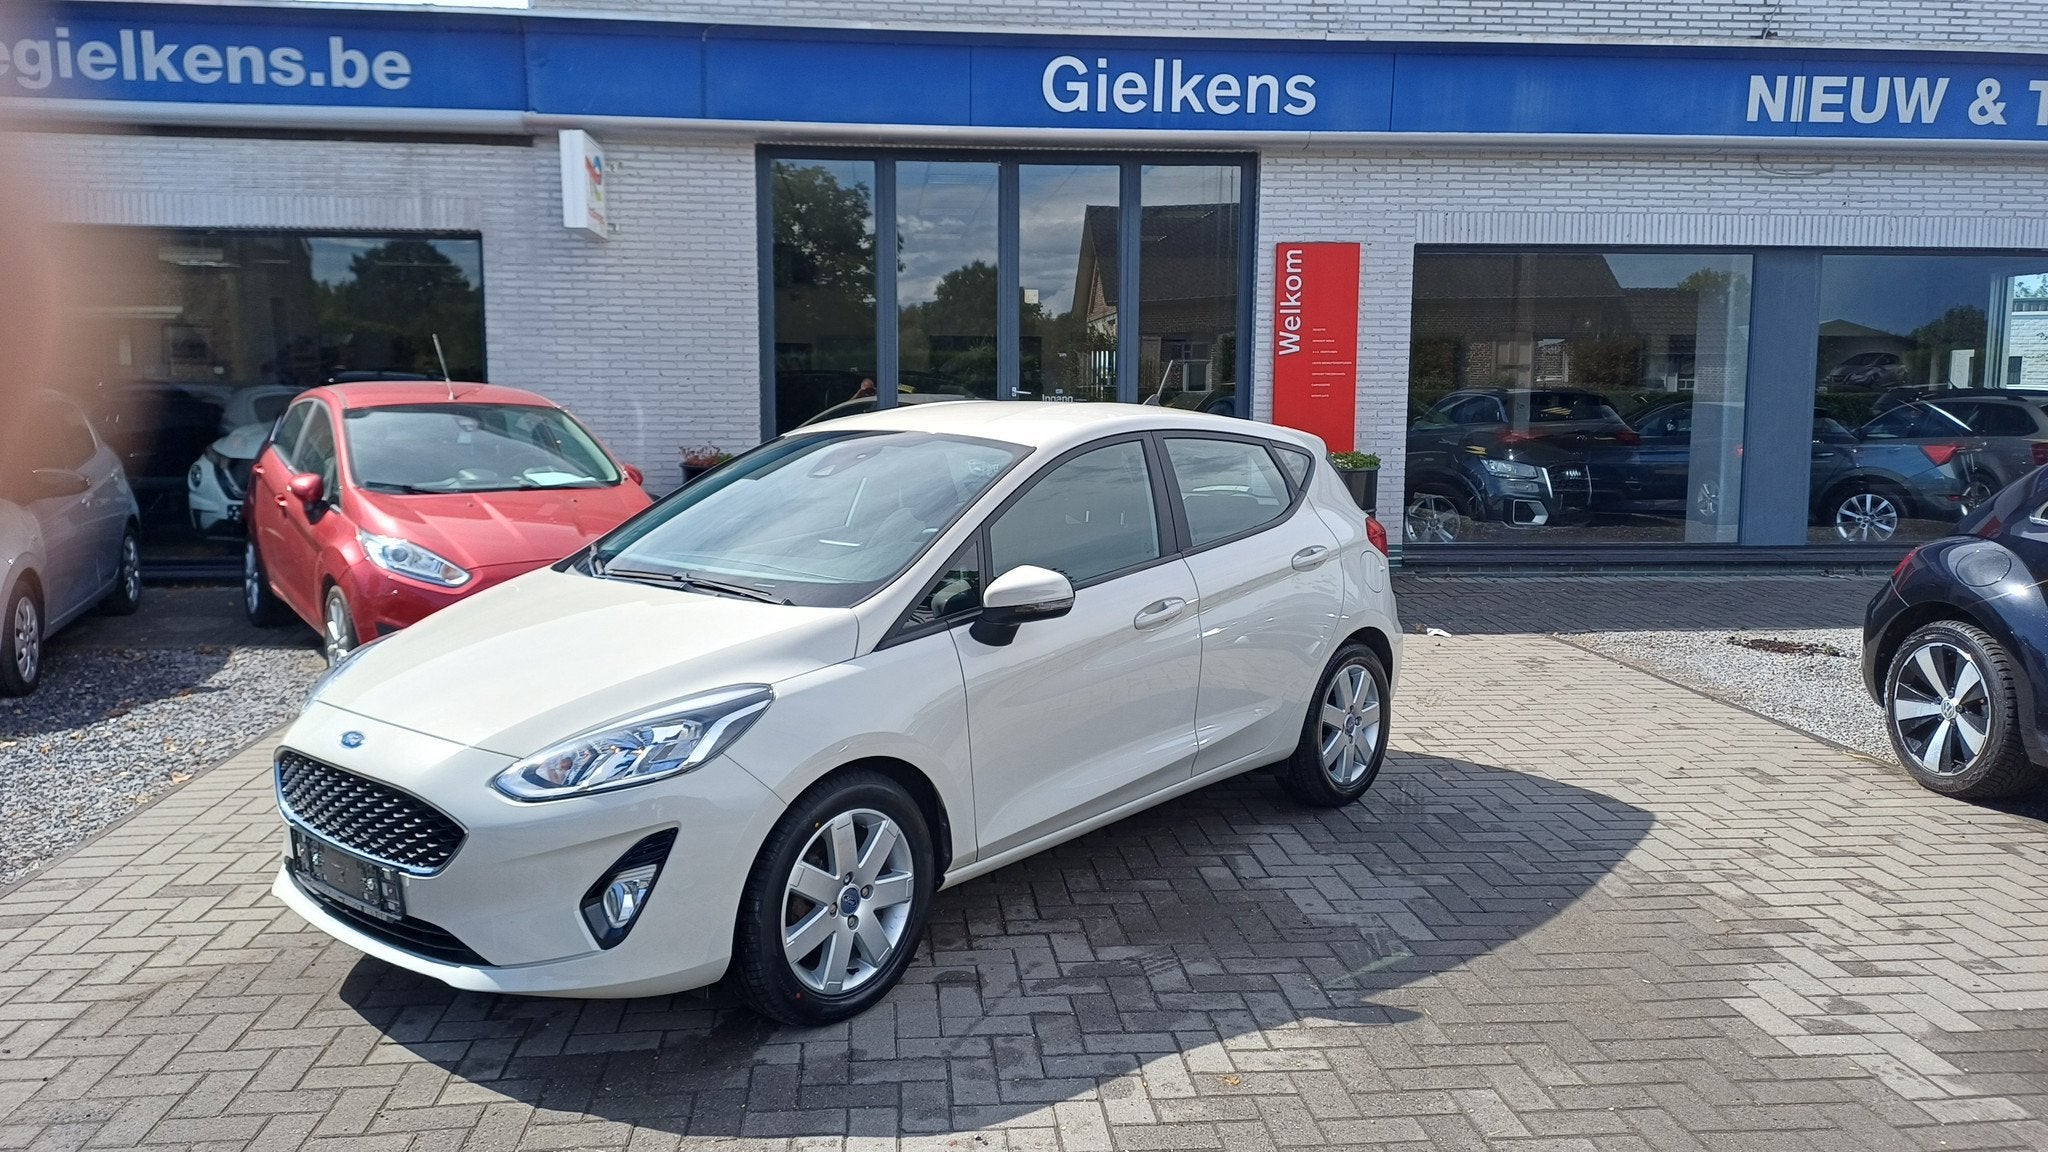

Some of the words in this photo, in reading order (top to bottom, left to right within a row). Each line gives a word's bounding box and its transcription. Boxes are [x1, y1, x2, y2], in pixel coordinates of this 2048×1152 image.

[0, 27, 411, 90] gielkens.be
[1042, 55, 1317, 116] Gielkens
[1746, 75, 1950, 125] NIEUW
[1967, 78, 2007, 126] &
[1278, 249, 1303, 356] Welkom
